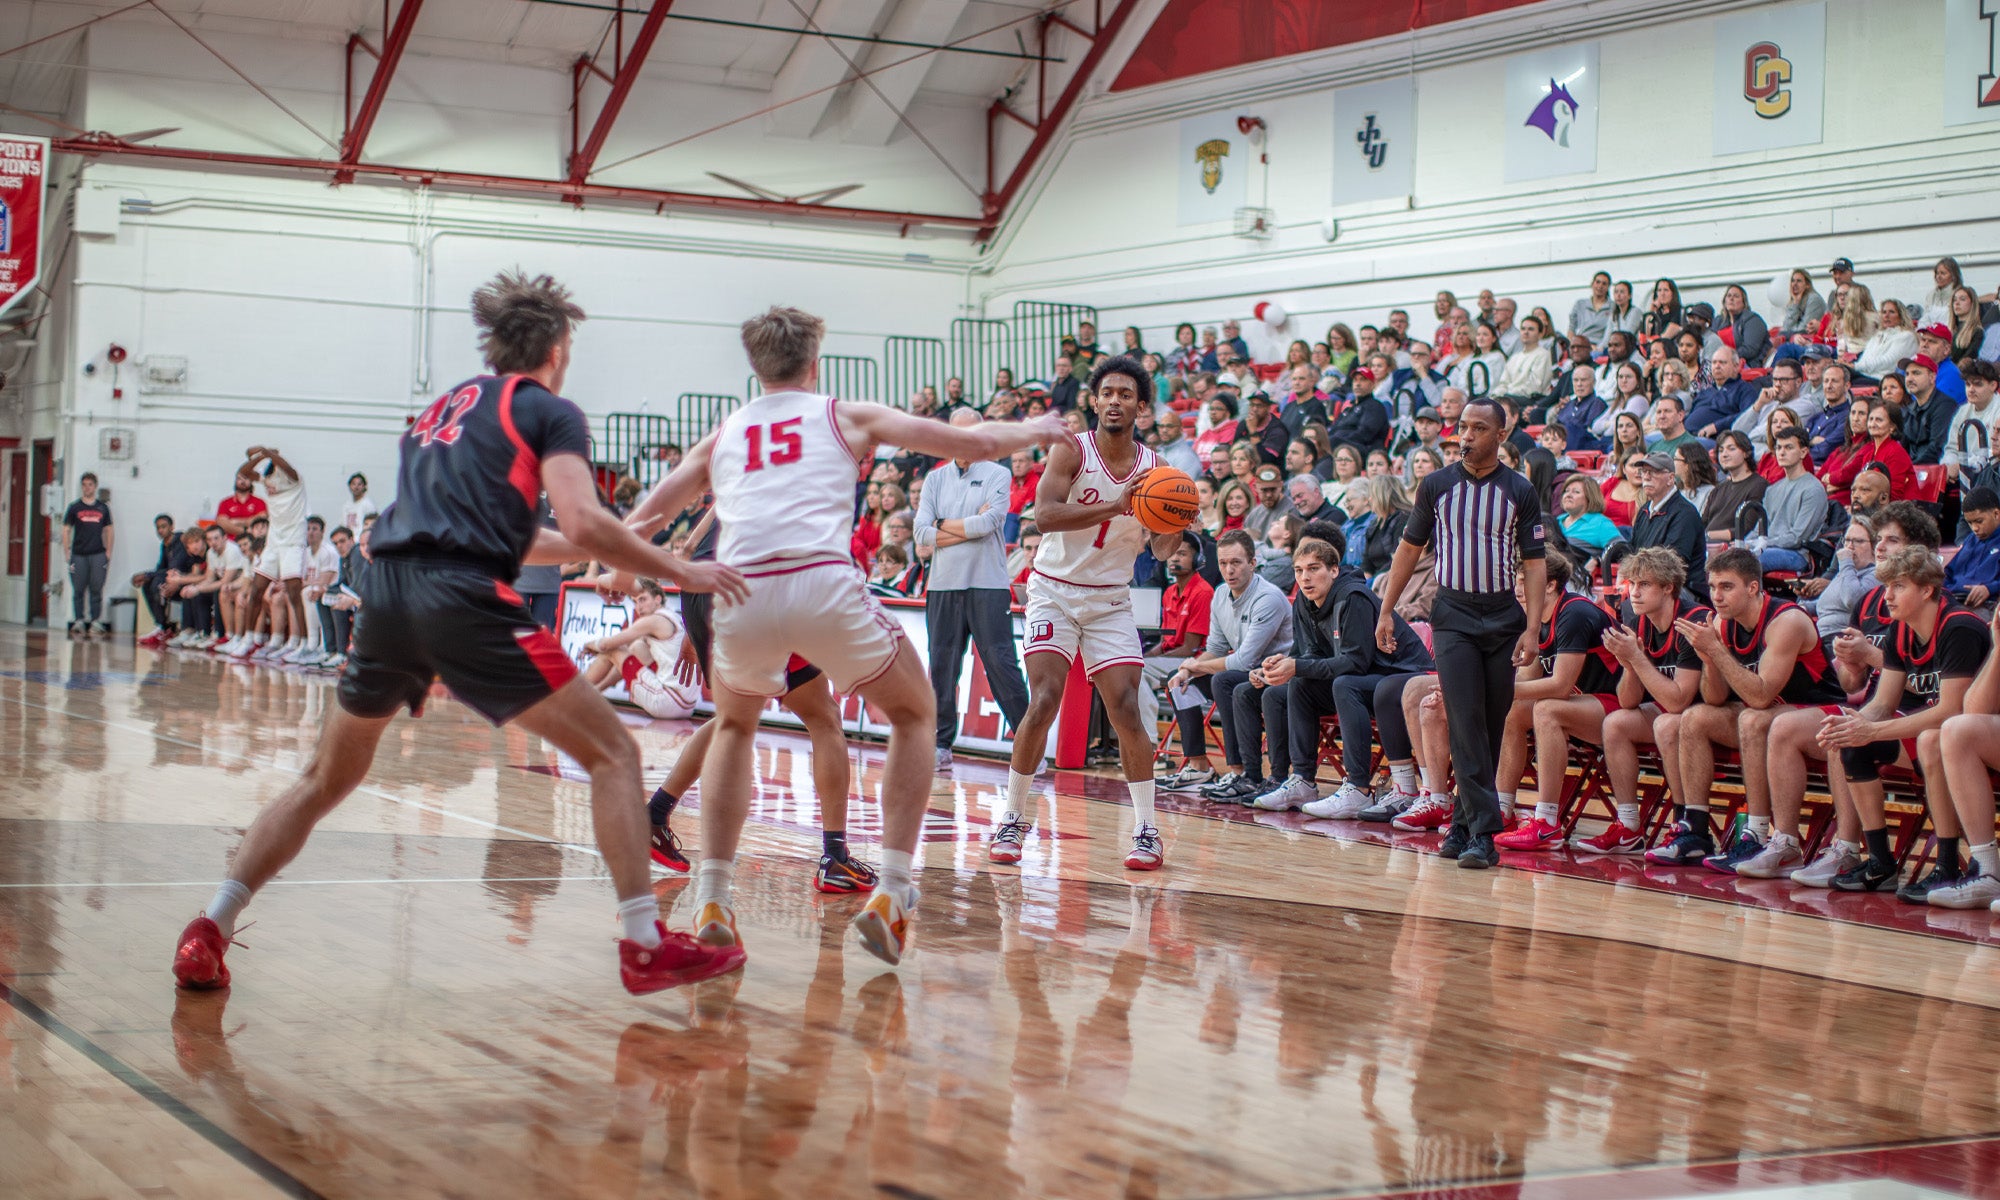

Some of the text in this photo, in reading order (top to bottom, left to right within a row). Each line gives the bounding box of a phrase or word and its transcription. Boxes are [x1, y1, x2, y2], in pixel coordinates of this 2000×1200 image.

[411, 384, 482, 447] 42
[743, 415, 803, 474] 15
[1030, 619, 1054, 643] D
